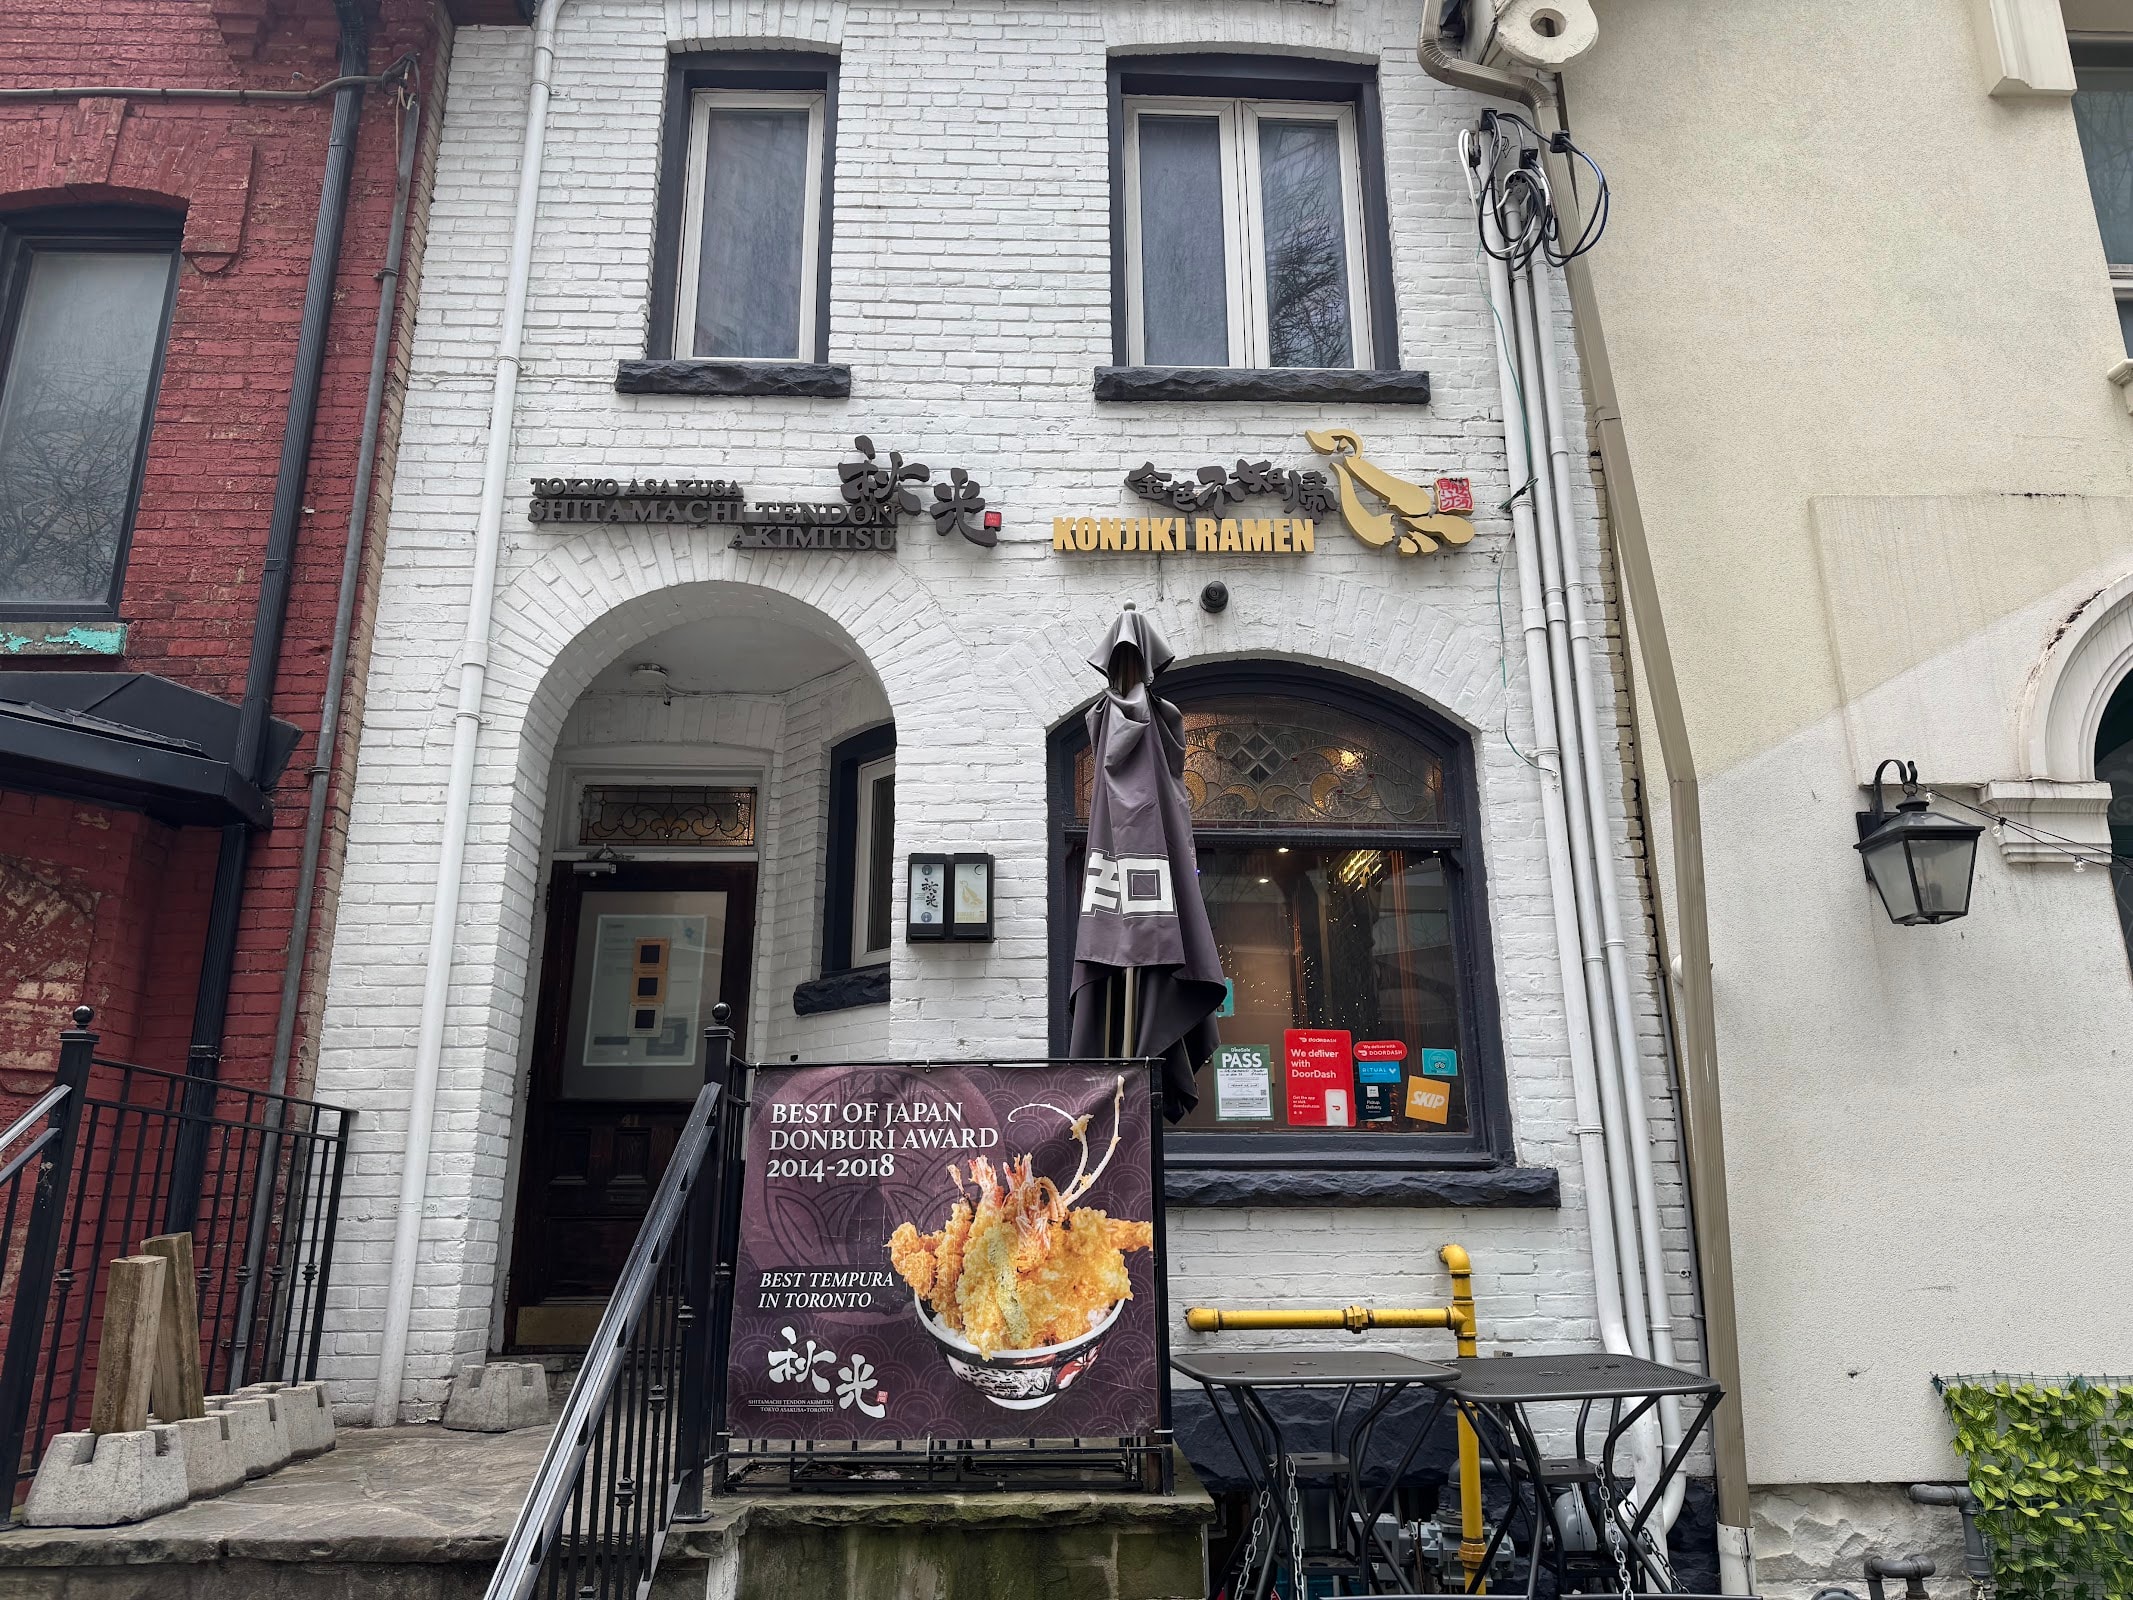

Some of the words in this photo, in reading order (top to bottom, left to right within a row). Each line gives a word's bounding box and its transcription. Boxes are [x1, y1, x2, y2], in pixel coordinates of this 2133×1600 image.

[531, 478, 619, 497] TOKYO
[624, 478, 743, 498] ASAKUSA
[528, 499, 744, 523] SHITAMACHI
[756, 502, 896, 525] TENDON
[729, 526, 896, 550] AKIMITSU
[1053, 517, 1187, 551] KONJIKI
[1196, 518, 1315, 553] RAMEN
[1221, 1053, 1263, 1068] PASS
[1290, 1048, 1306, 1058] We
[1308, 1049, 1340, 1058] deliver
[1290, 1059, 1311, 1068] with
[1291, 1069, 1337, 1079] DoorDash
[1411, 1090, 1446, 1109] SKIP
[771, 1103, 834, 1124] BEST
[842, 1103, 878, 1124] OF
[883, 1102, 963, 1128] JAPAN
[769, 1128, 895, 1151] DONBURI
[901, 1127, 998, 1149] AWARD
[767, 1154, 895, 1183] 2014-2018
[759, 1272, 805, 1288] BEST
[809, 1271, 894, 1288] TEMPURA
[758, 1292, 780, 1308] IN
[784, 1292, 872, 1308] TORONTO
[767, 1326, 886, 1418] 秋光
